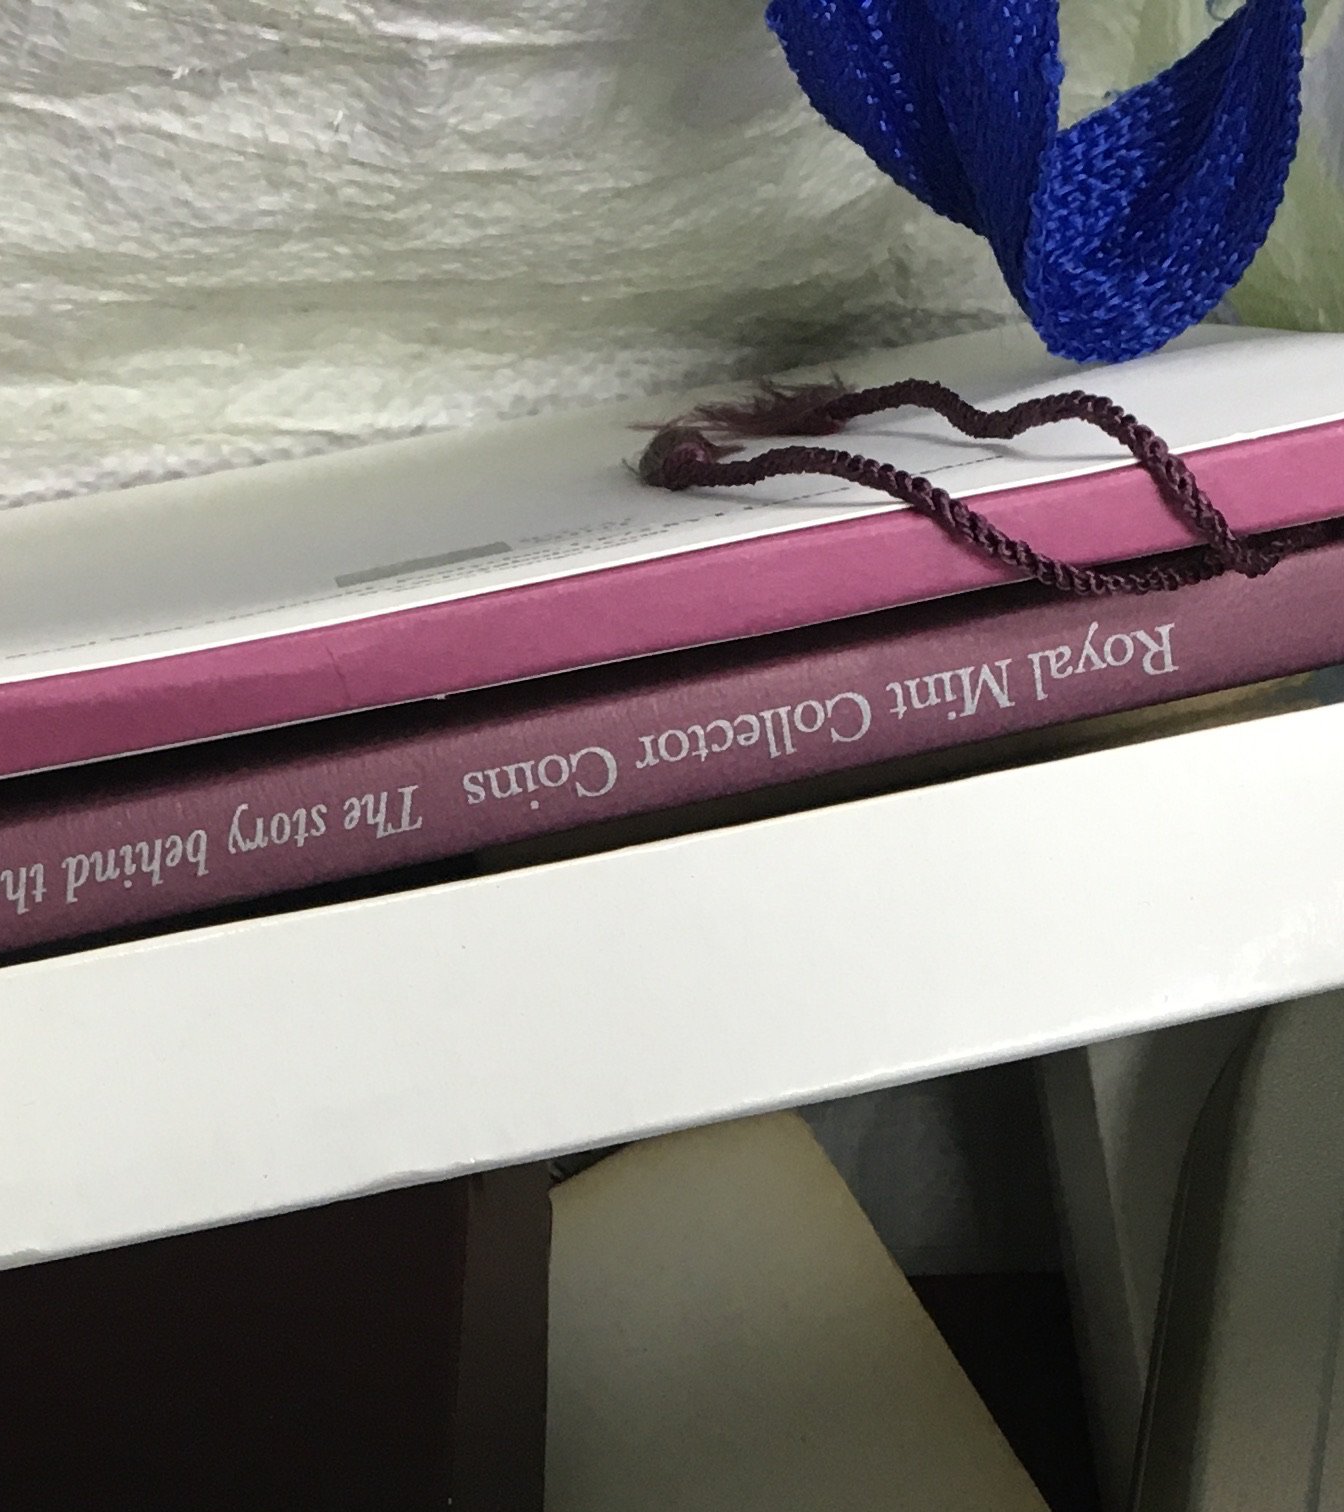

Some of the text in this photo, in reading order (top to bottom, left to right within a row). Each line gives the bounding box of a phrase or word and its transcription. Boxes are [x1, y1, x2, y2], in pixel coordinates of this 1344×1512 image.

[884, 656, 1017, 722] Mint
[1026, 619, 1181, 702] Royal
[634, 690, 873, 770] Collector
[461, 745, 619, 811] Coins
[227, 802, 329, 856] story
[342, 783, 424, 840] The
[60, 828, 210, 905] behind
